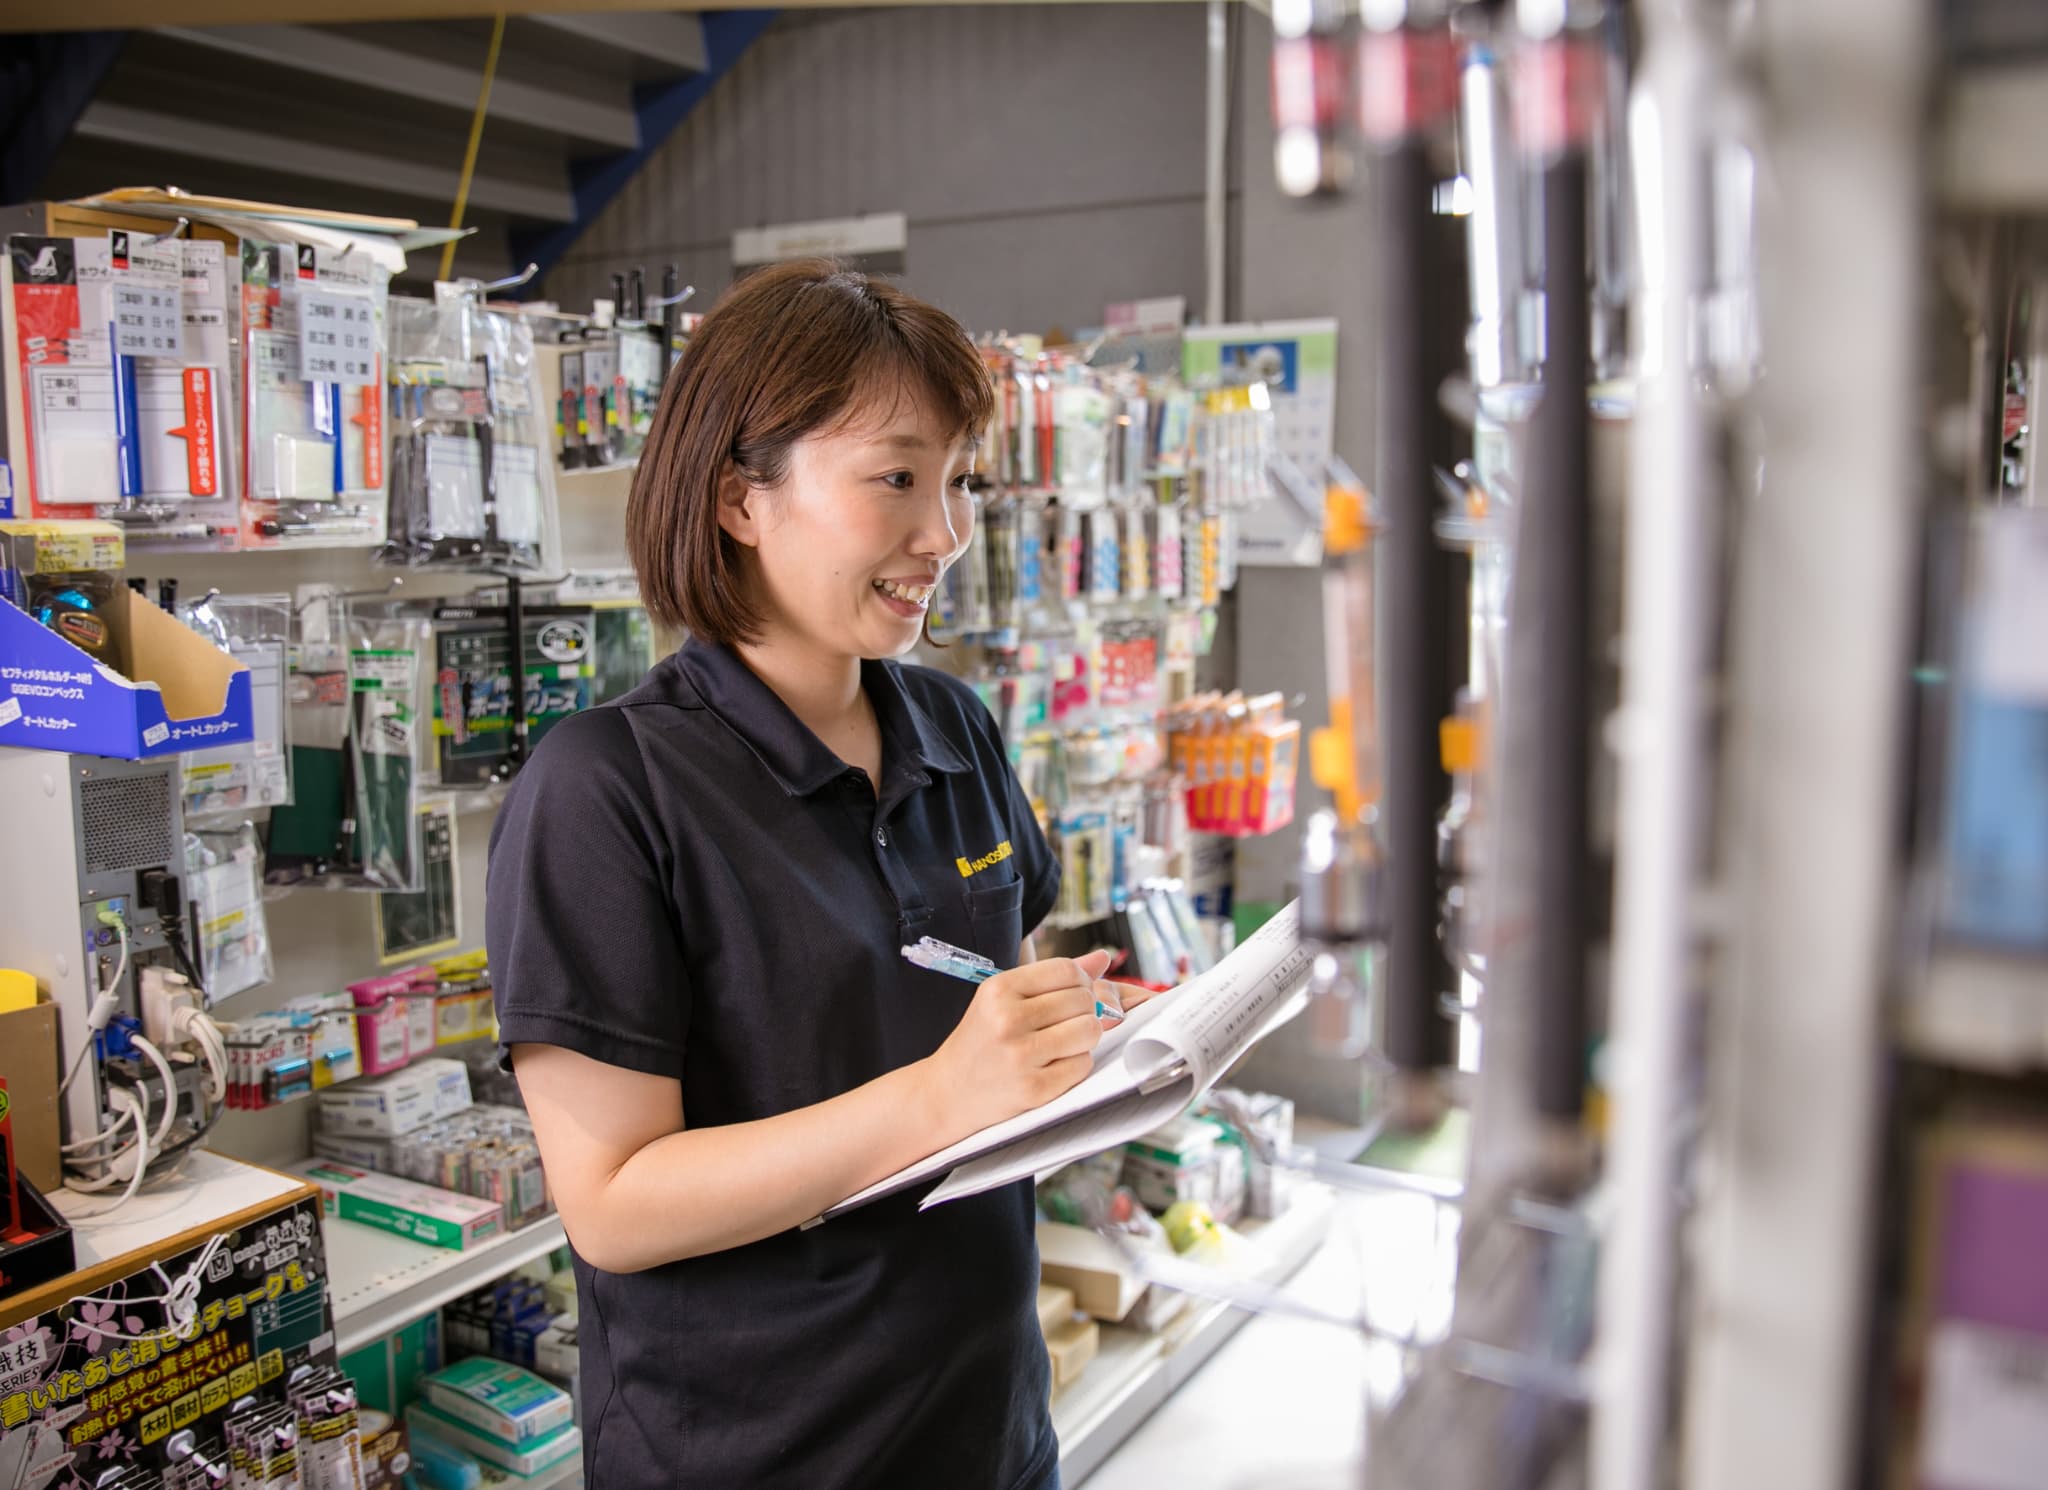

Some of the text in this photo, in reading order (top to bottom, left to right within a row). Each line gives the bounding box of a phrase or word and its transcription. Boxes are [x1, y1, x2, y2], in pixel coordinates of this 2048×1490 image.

[46, 378, 76, 390] 工事名
[23, 716, 77, 730] オートLカッター
[172, 721, 239, 740] オートLカッター
[256, 1039, 285, 1064] 2CR5
[143, 1412, 169, 1437] 木材
[202, 1382, 229, 1406] ガラス
